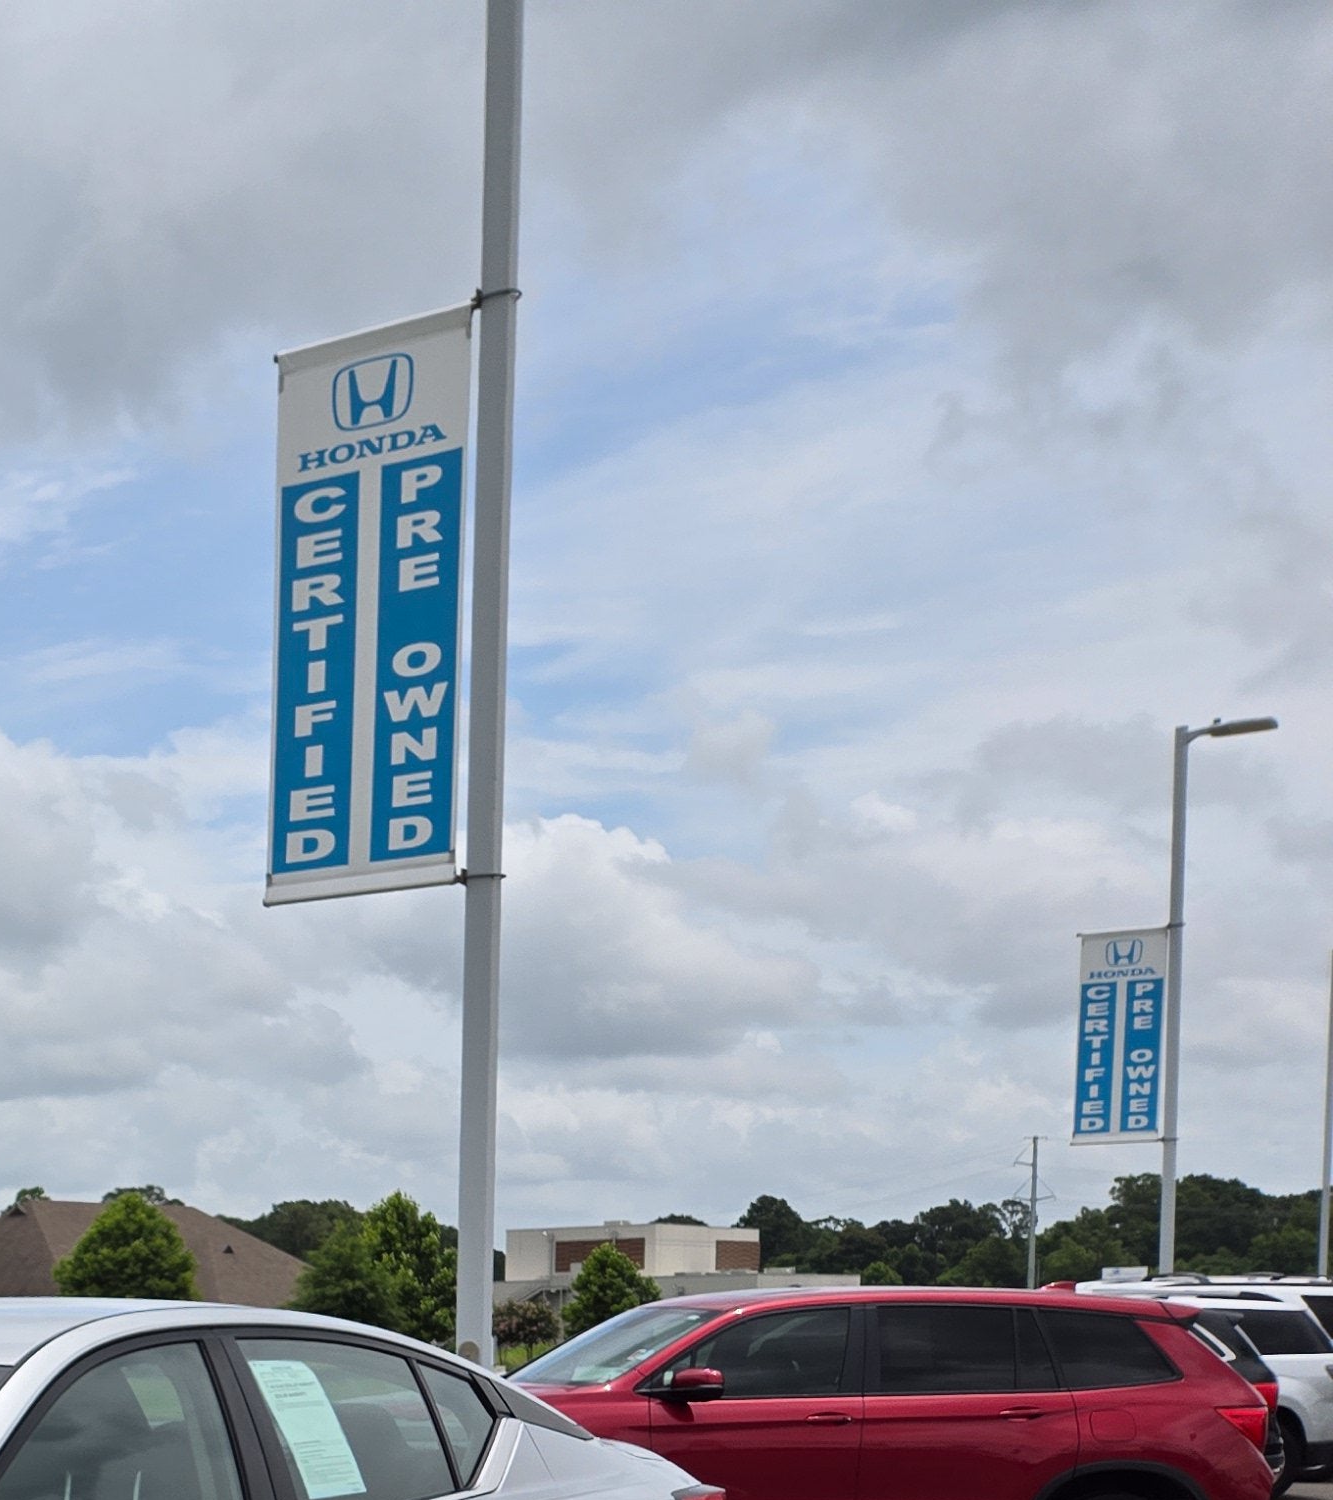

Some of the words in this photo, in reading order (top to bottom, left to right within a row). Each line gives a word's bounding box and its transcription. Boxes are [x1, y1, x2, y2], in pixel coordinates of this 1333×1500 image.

[297, 423, 447, 472] HONDA
[396, 464, 443, 592] PRE
[285, 487, 347, 865] CERTIFIED
[383, 641, 448, 852] OWNED
[1089, 967, 1156, 979] HONDA
[1133, 982, 1154, 1030] PRE
[1080, 985, 1110, 1131] CERTIFIED
[1126, 1048, 1155, 1129] OWNED
